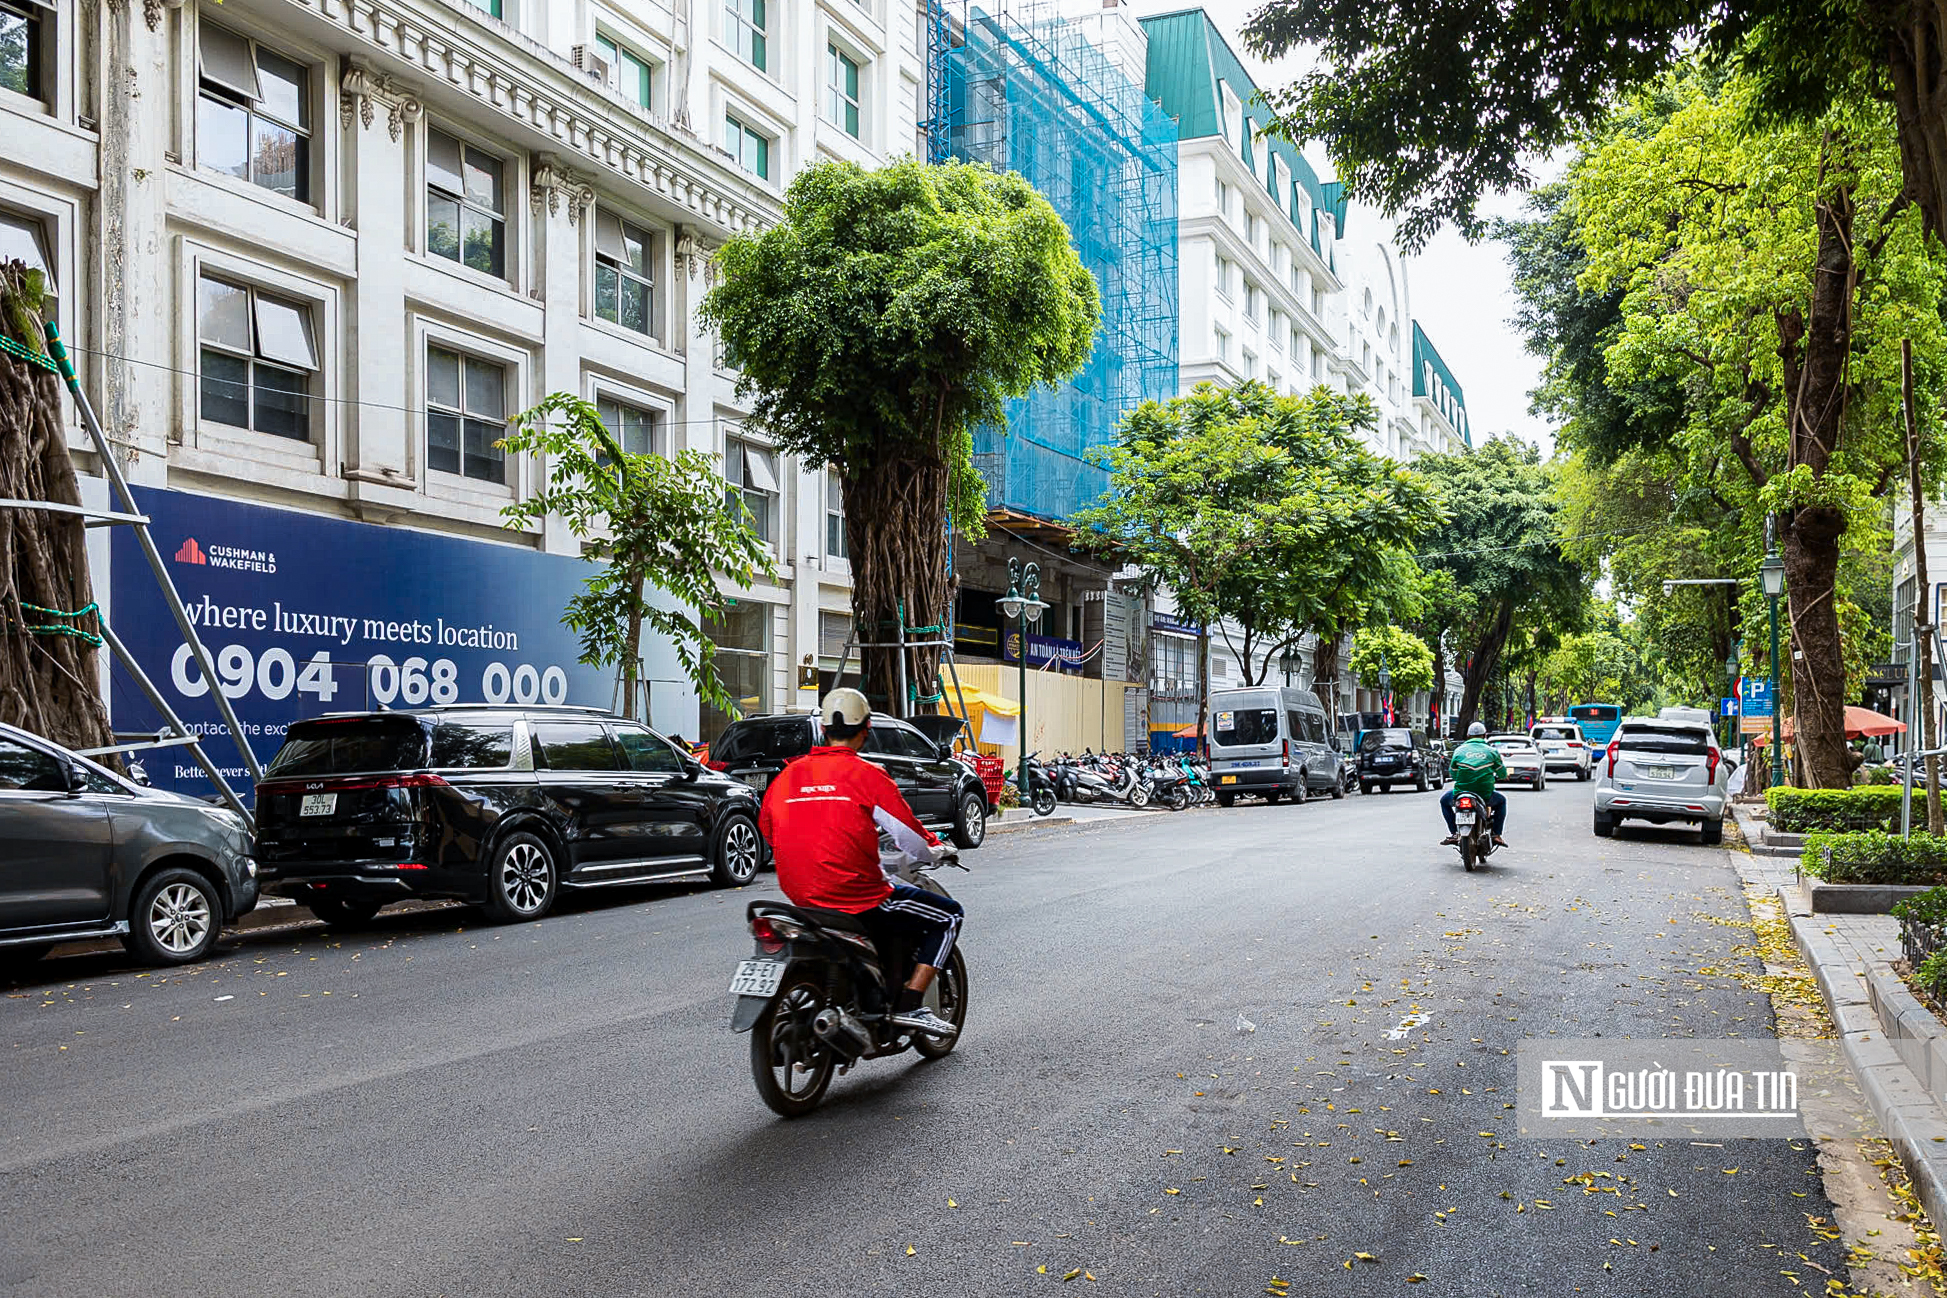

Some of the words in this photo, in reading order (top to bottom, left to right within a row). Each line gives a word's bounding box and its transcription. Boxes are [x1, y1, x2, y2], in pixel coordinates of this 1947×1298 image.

[209, 545, 266, 562] CUSHMAN
[268, 553, 276, 563] &
[209, 556, 277, 574] WAKEFIELD
[184, 595, 267, 631] where
[274, 602, 358, 646] luxury
[363, 618, 432, 644] meets
[437, 618, 518, 650] location
[1030, 642, 1039, 657] AN
[1039, 642, 1053, 659] TOÀN
[1060, 645, 1072, 662] TRÊN
[171, 641, 338, 702] 0904
[367, 654, 459, 705] 068
[482, 662, 568, 705] 000
[1751, 682, 1765, 698] P
[311, 795, 326, 805] 30L
[304, 805, 332, 815] 553.73
[733, 977, 775, 994] 172.92
